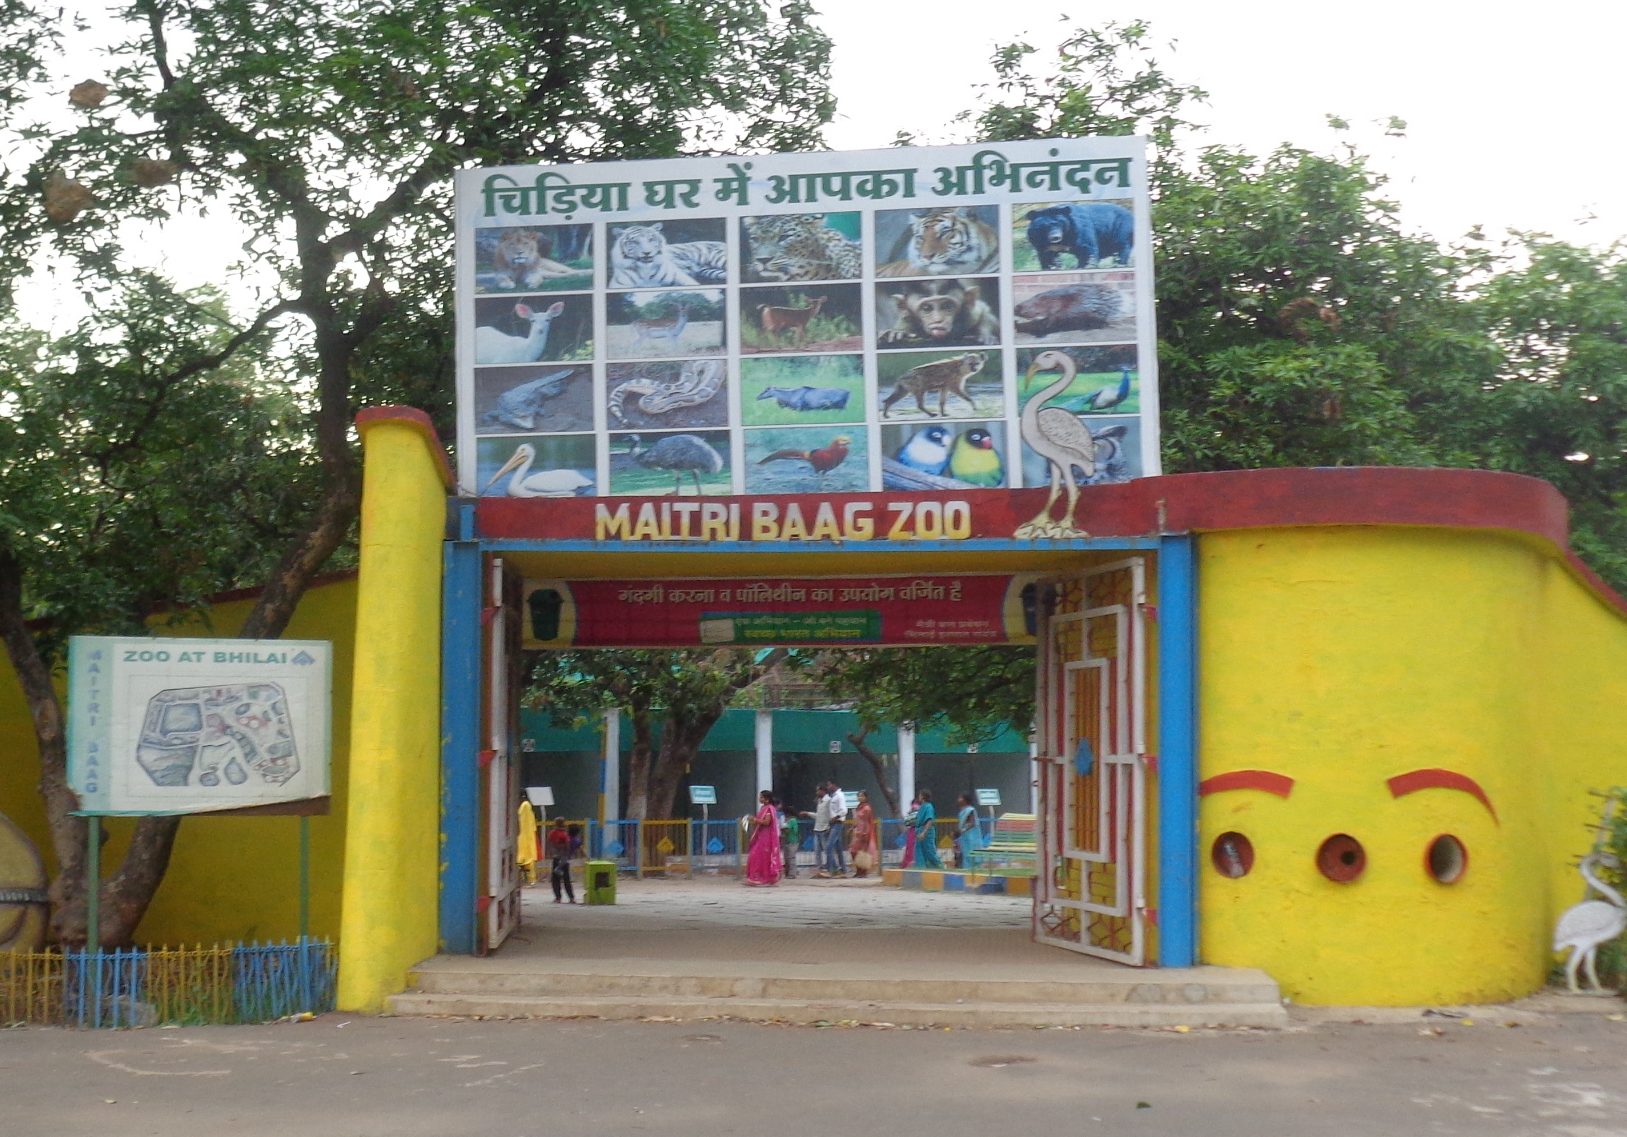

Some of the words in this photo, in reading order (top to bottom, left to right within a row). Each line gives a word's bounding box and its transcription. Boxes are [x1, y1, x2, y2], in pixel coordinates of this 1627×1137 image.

[481, 171, 631, 220] चिड़िया
[643, 178, 702, 209] घर
[713, 161, 754, 206] में
[765, 167, 918, 204] आपका
[932, 147, 1133, 196] अभिनंदन
[595, 501, 740, 541] MAITRI
[751, 501, 874, 541] BAAG
[888, 500, 971, 540] ZOO
[617, 584, 665, 604] गंदगी
[668, 589, 715, 603] करना
[719, 589, 731, 603] व
[736, 582, 805, 603] पॉलिथीन
[811, 587, 833, 602] का
[839, 582, 895, 601] उपयोग
[900, 580, 945, 601] वर्जित
[949, 580, 963, 602] है
[123, 650, 171, 662] ZOO
[177, 651, 206, 663] AT
[213, 652, 287, 664] BHILAI
